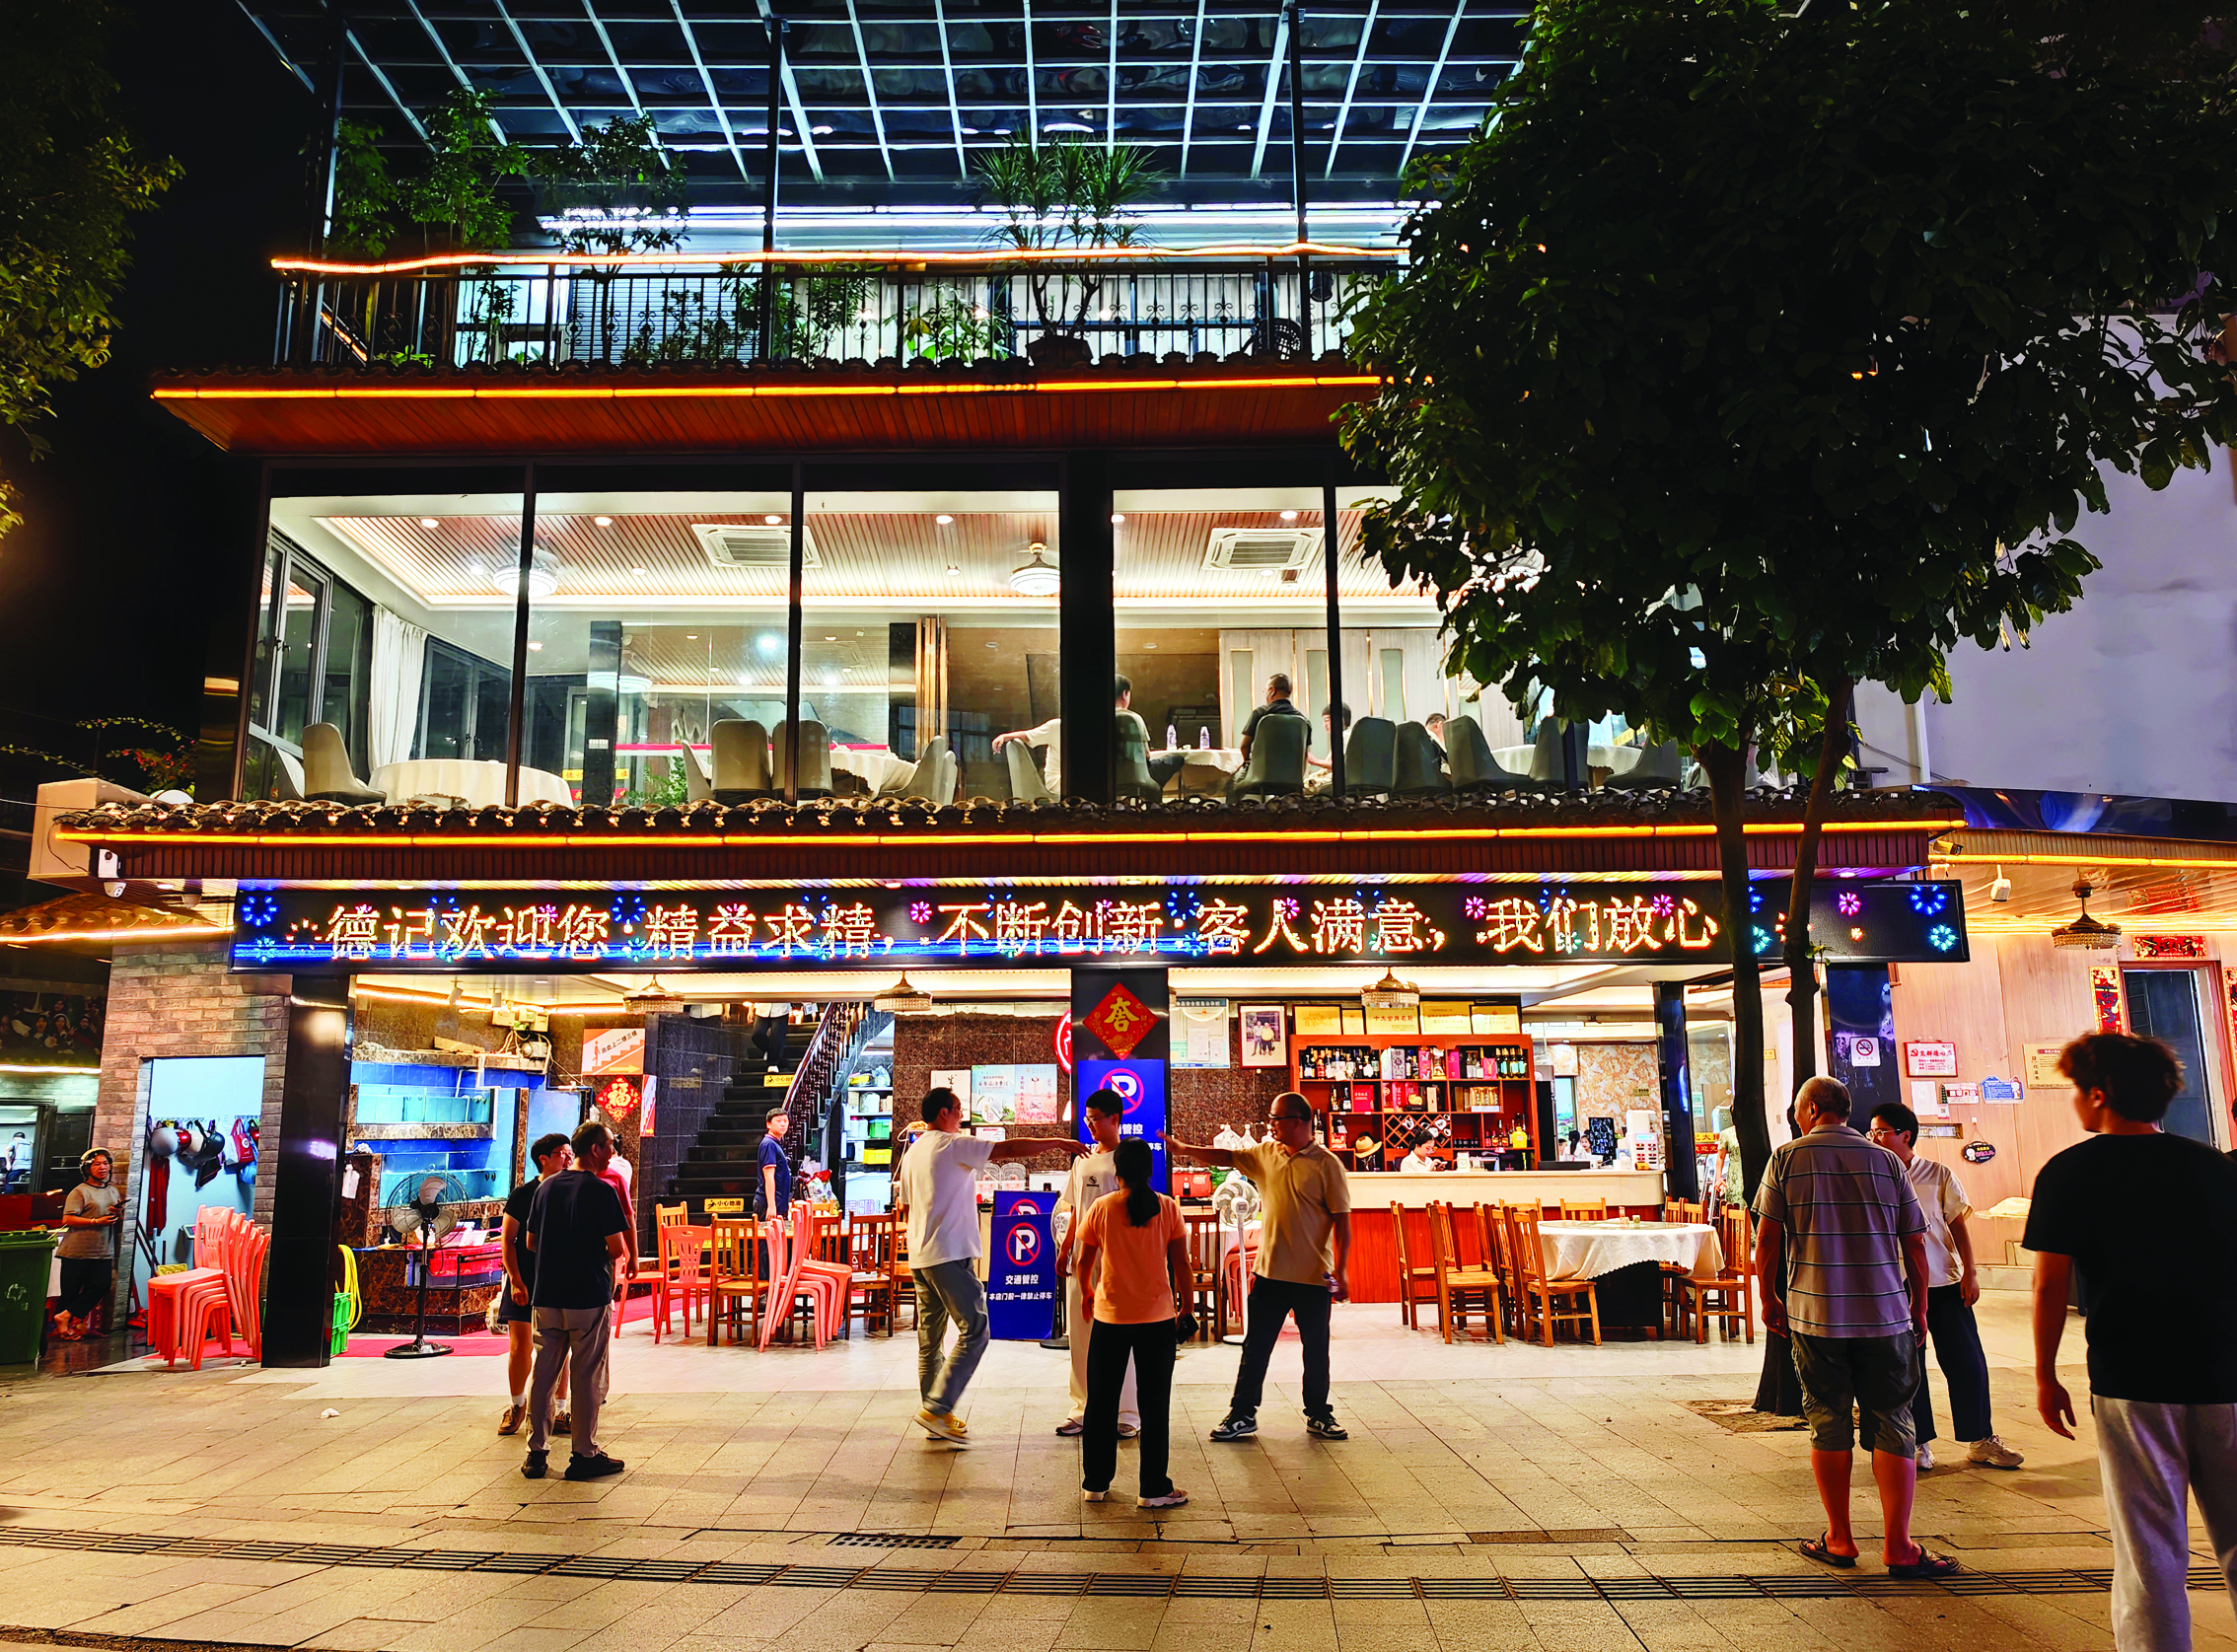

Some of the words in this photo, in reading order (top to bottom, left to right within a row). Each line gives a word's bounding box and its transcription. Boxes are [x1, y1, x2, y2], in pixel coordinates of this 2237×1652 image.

[326, 902, 610, 960] 德记欢迎您
[938, 898, 1164, 957] 不断创新
[1485, 896, 1719, 953] 我们放心
[1118, 1123, 1144, 1135] 管控
[1005, 1274, 1039, 1285] 交通管控
